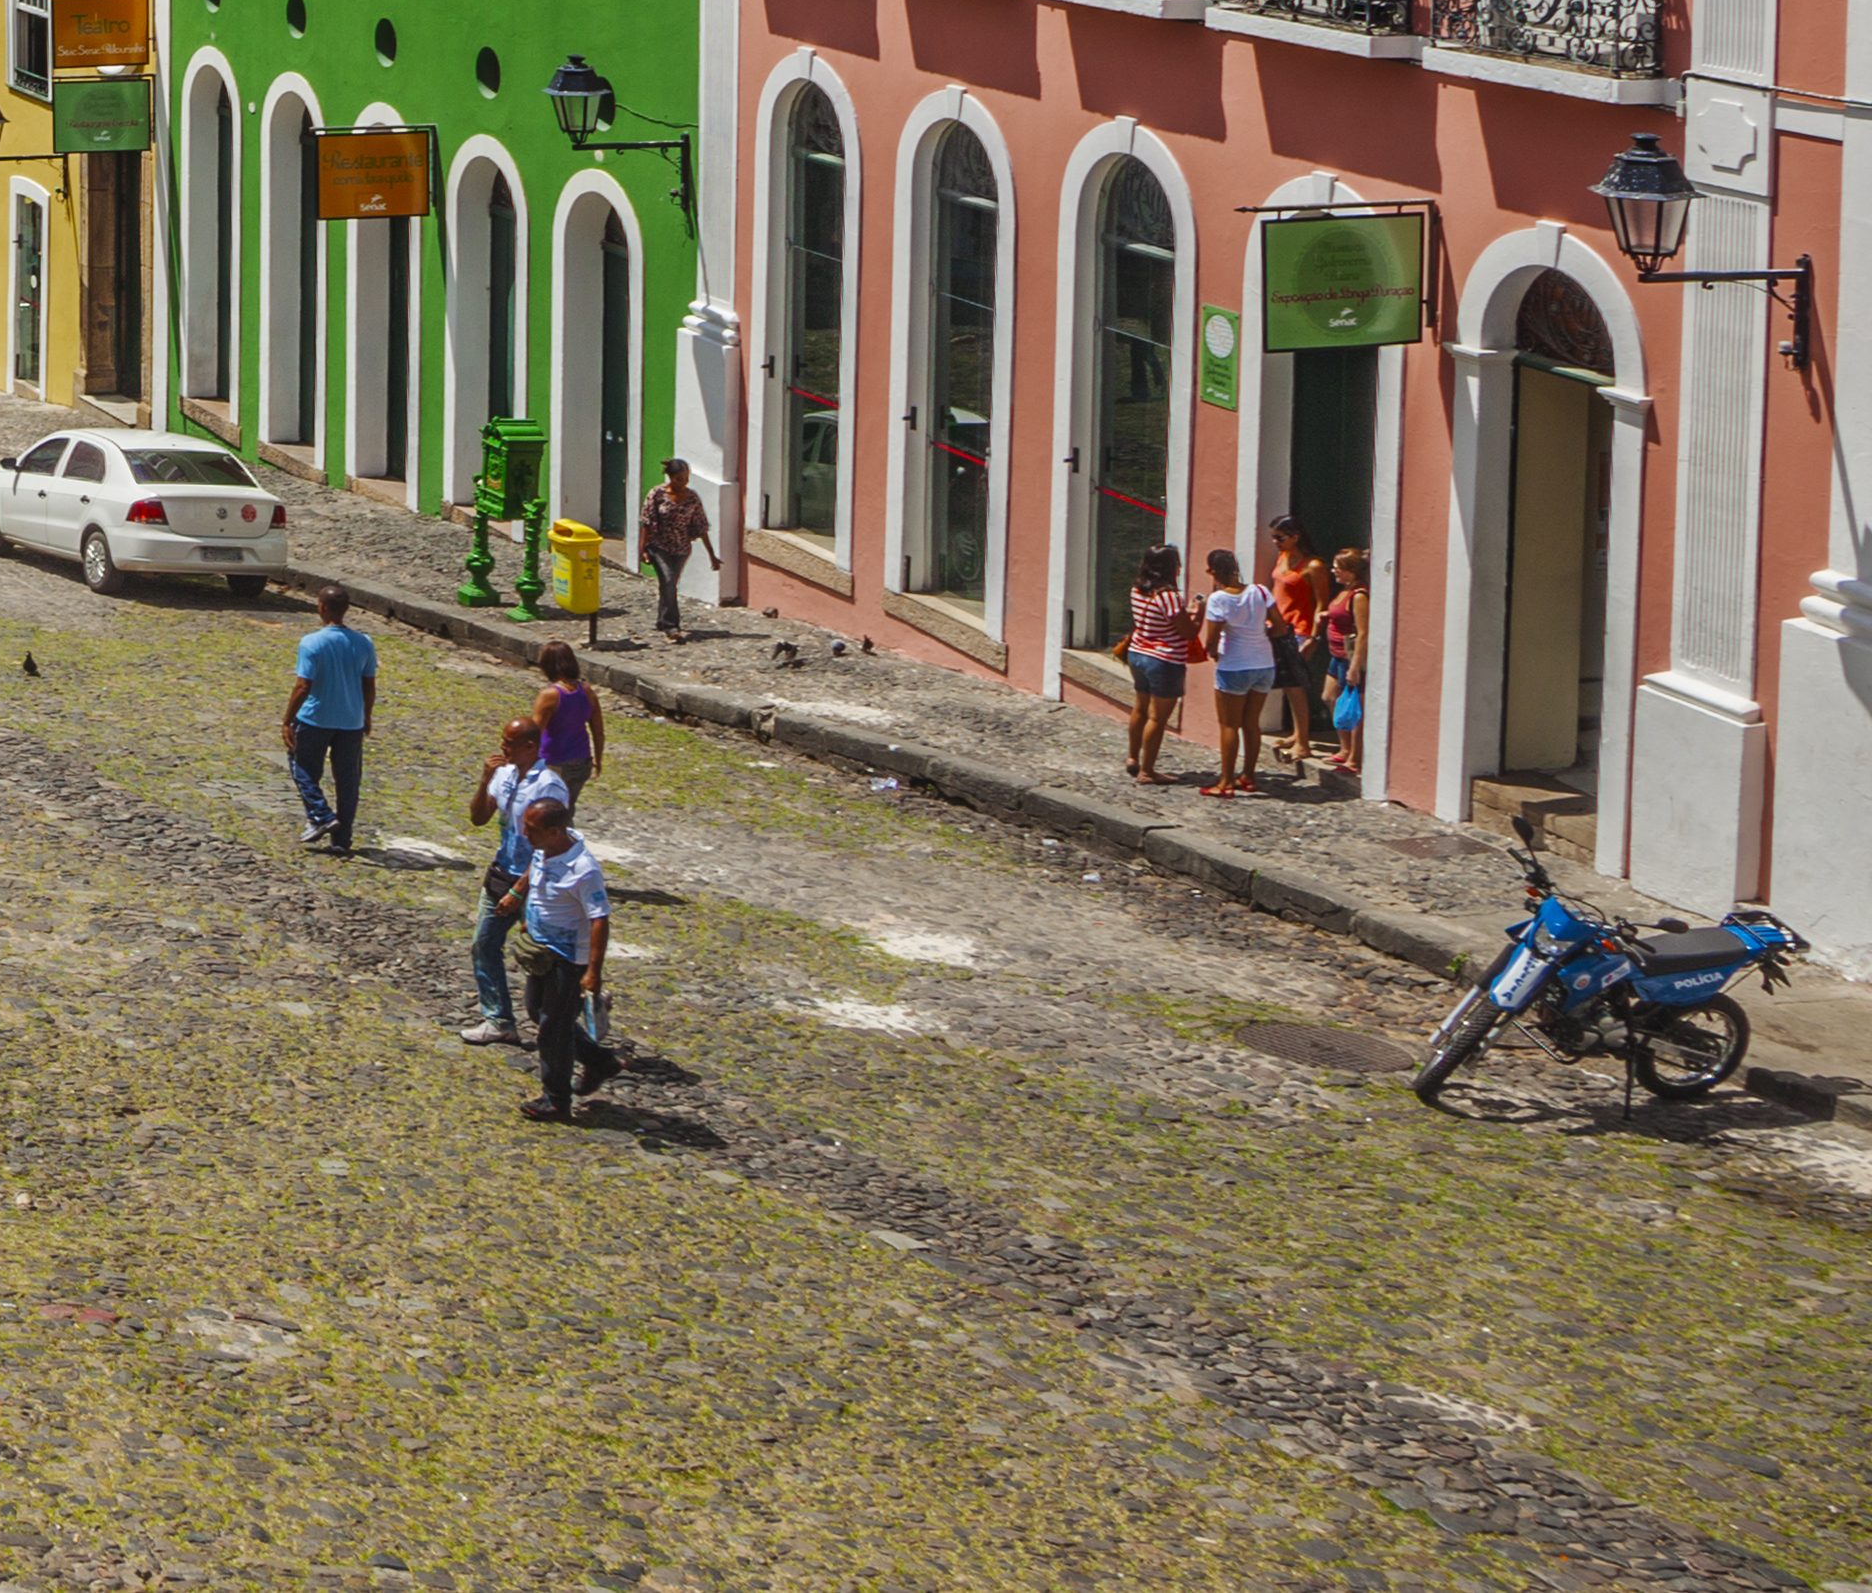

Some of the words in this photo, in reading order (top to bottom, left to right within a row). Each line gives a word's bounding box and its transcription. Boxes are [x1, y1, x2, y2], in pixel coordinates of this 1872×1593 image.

[71, 13, 130, 35] Teatro
[322, 149, 424, 170] Restaurante
[1673, 971, 1725, 990] POLÍCIA
